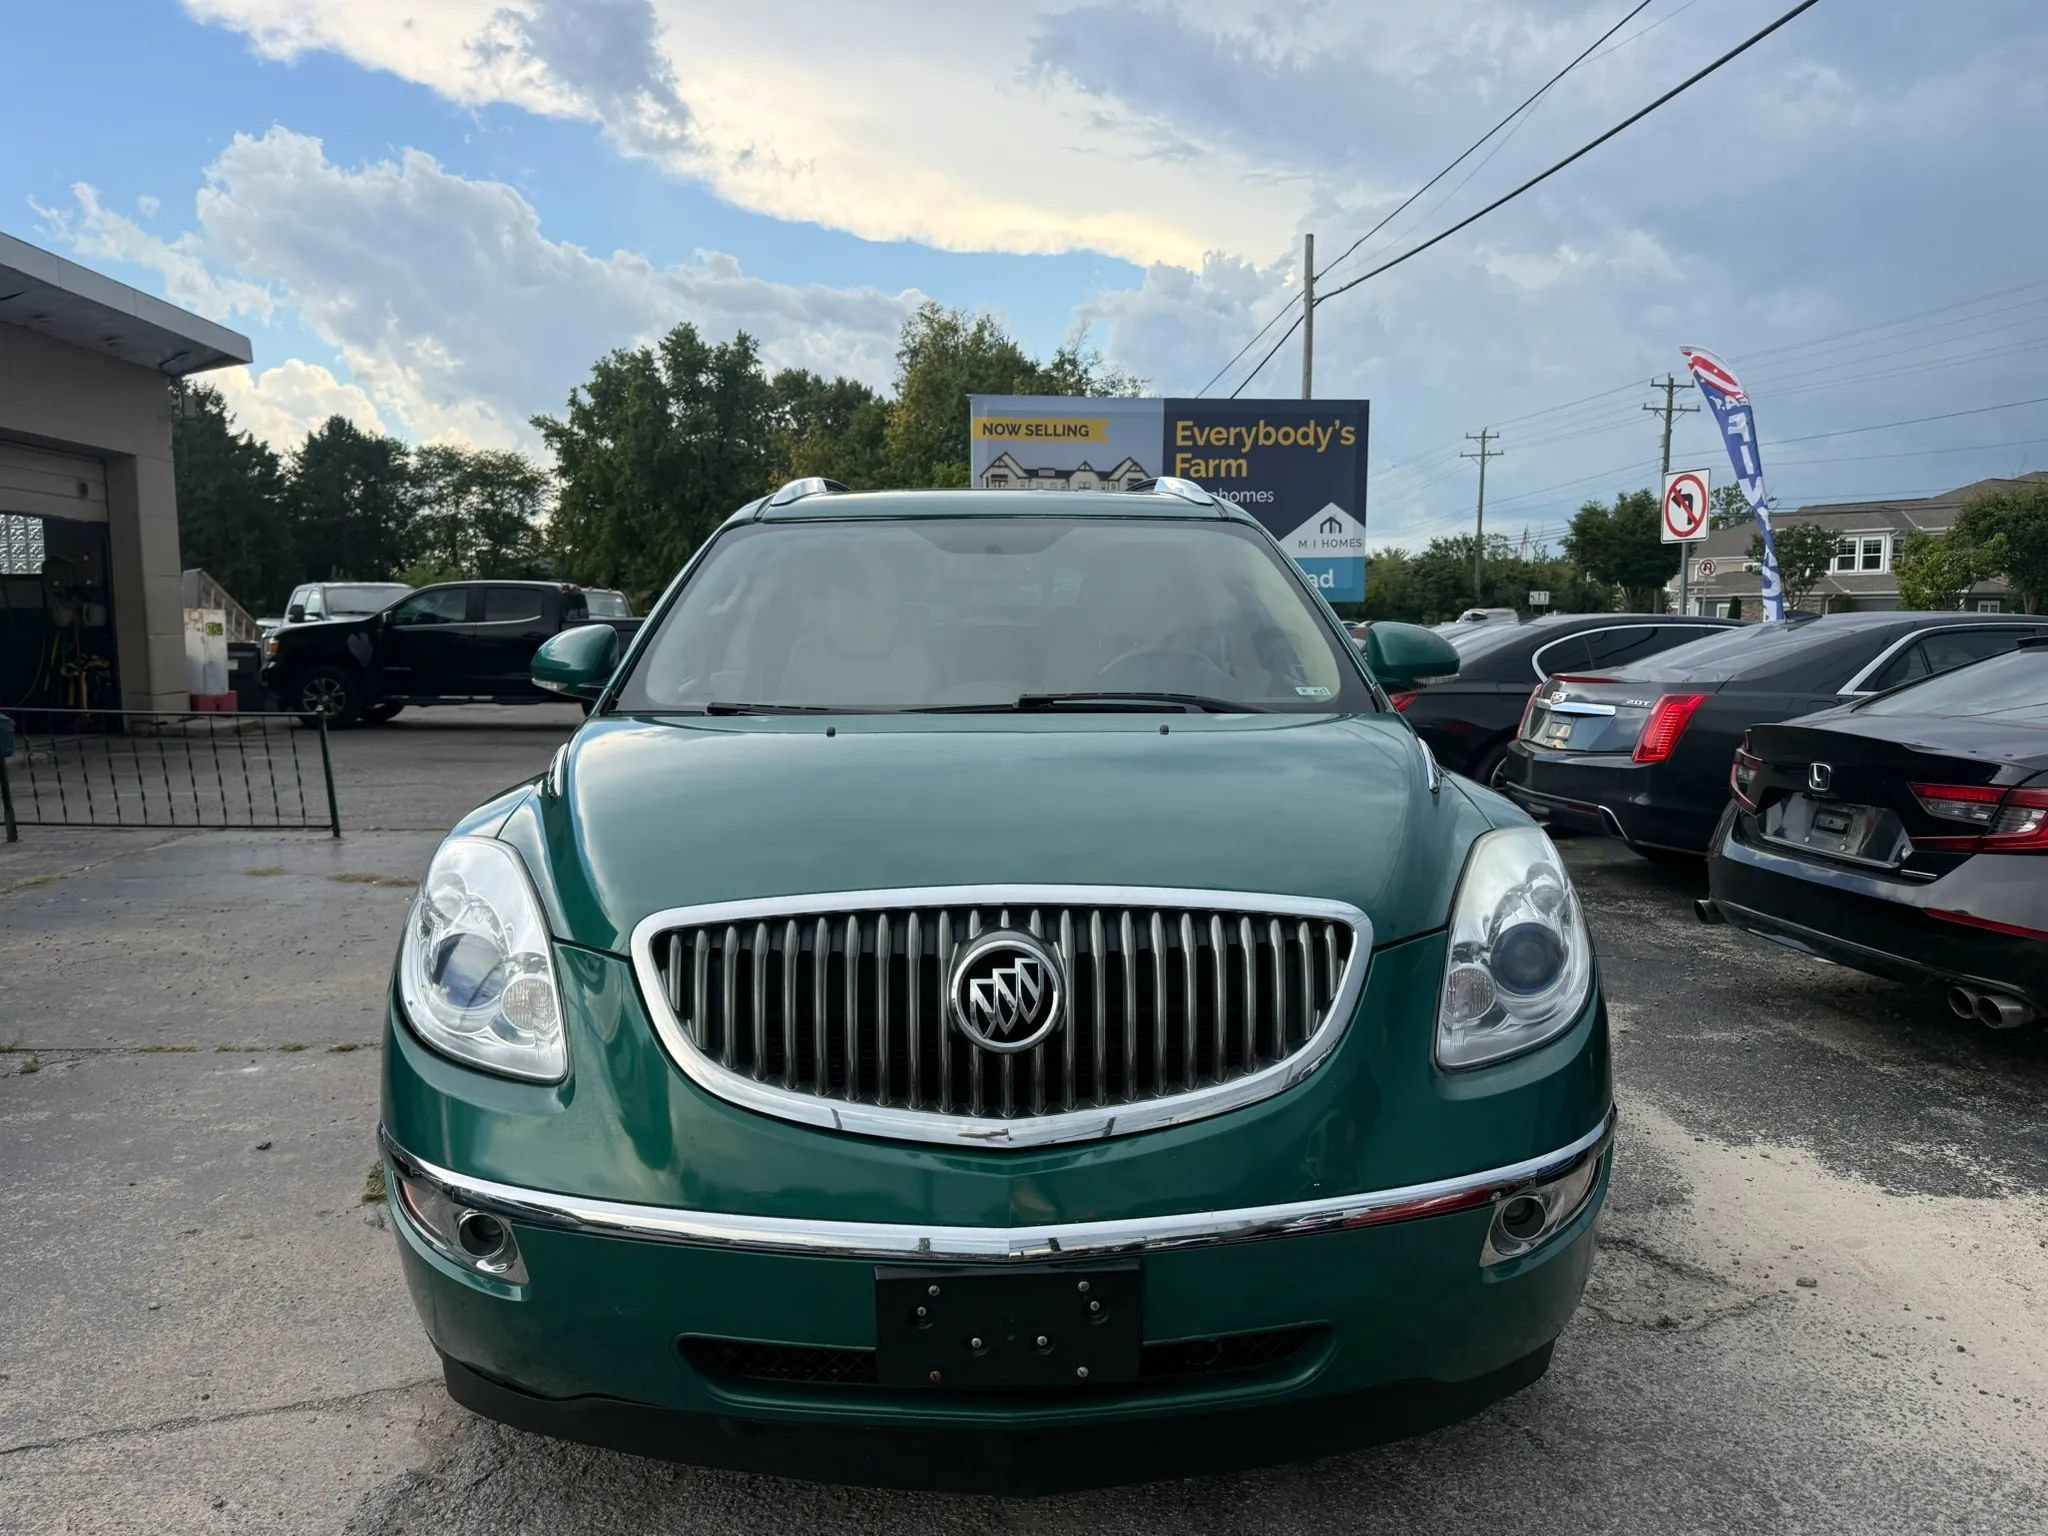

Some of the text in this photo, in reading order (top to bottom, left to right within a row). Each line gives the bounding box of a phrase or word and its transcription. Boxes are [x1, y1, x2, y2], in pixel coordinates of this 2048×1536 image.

[982, 423, 1090, 438] NOW SELLING
[1175, 419, 1356, 453] Everybody's
[1174, 452, 1249, 479] Farm
[1321, 538, 1363, 549] HOMES
[1306, 568, 1335, 589] ad
